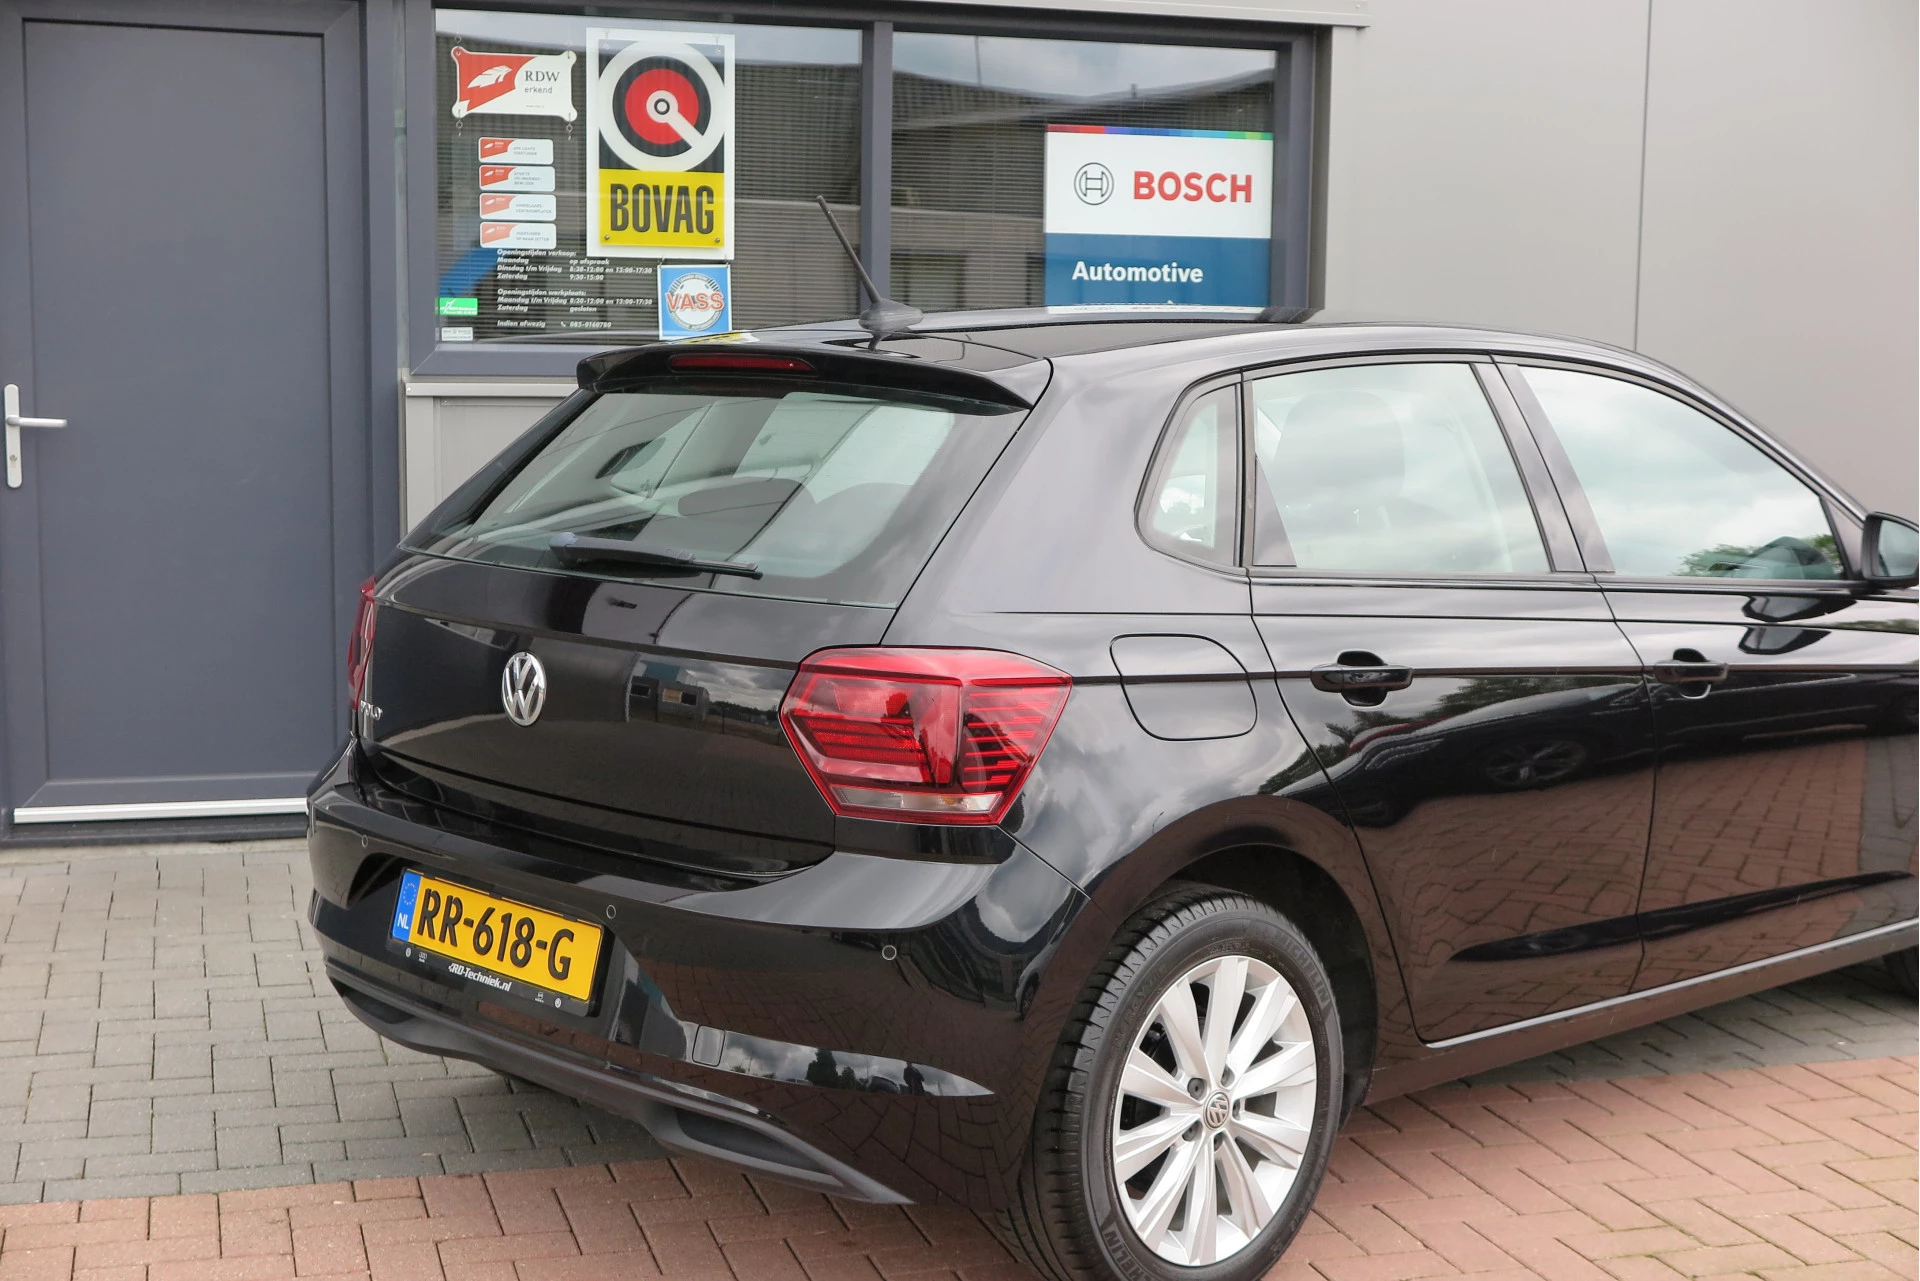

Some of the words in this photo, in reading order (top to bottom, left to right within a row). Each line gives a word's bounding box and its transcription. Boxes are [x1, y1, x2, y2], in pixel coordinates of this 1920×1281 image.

[524, 70, 560, 82] RDW
[524, 86, 553, 94] erkend
[1133, 170, 1252, 203] BOSCH
[610, 183, 715, 235] BOVAG
[497, 248, 546, 257] Openingstijden
[1072, 261, 1203, 283] Automotive
[497, 288, 547, 296] Openingstijden
[548, 289, 587, 297] werkplaats:
[544, 297, 567, 305] Vrijdag
[665, 292, 725, 311] VASS
[497, 304, 529, 312] Zaterdag
[569, 305, 597, 313] gesloten
[519, 320, 546, 328] afwezig
[397, 912, 409, 930] NL
[416, 887, 575, 981] RR-618-G
